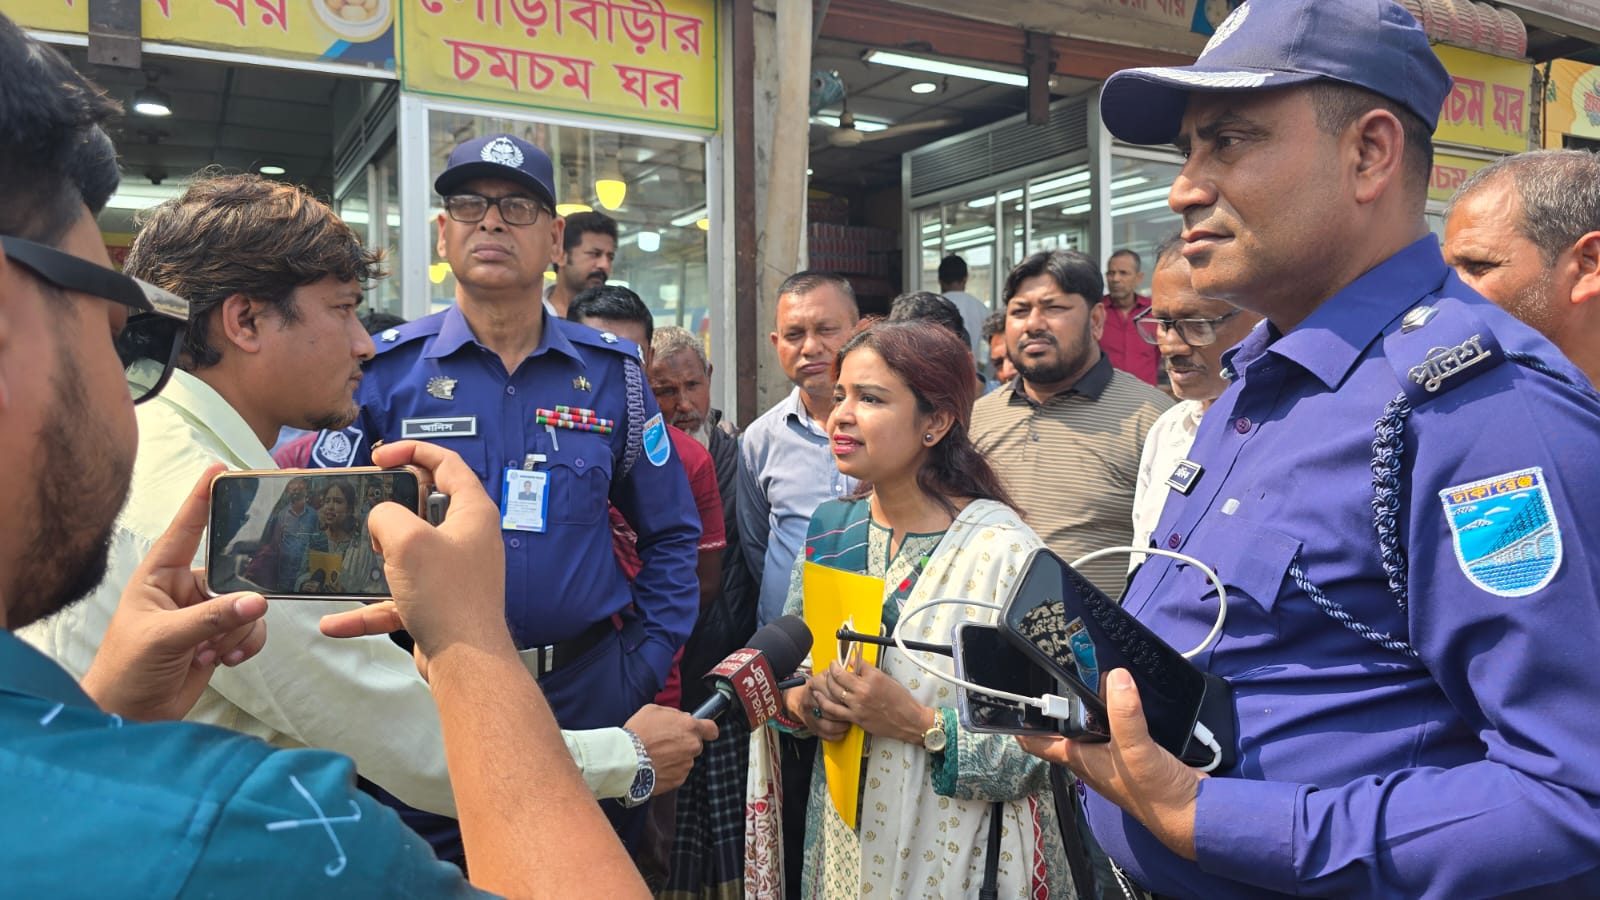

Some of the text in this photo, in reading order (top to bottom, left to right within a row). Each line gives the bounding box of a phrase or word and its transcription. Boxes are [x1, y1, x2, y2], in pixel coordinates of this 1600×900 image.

[444, 39, 683, 112] চমচম ঘর
[1493, 84, 1525, 133] ঘর
[1407, 334, 1492, 393] পুলিশ
[1451, 484, 1493, 503] ঢাকা
[749, 691, 767, 724] news
